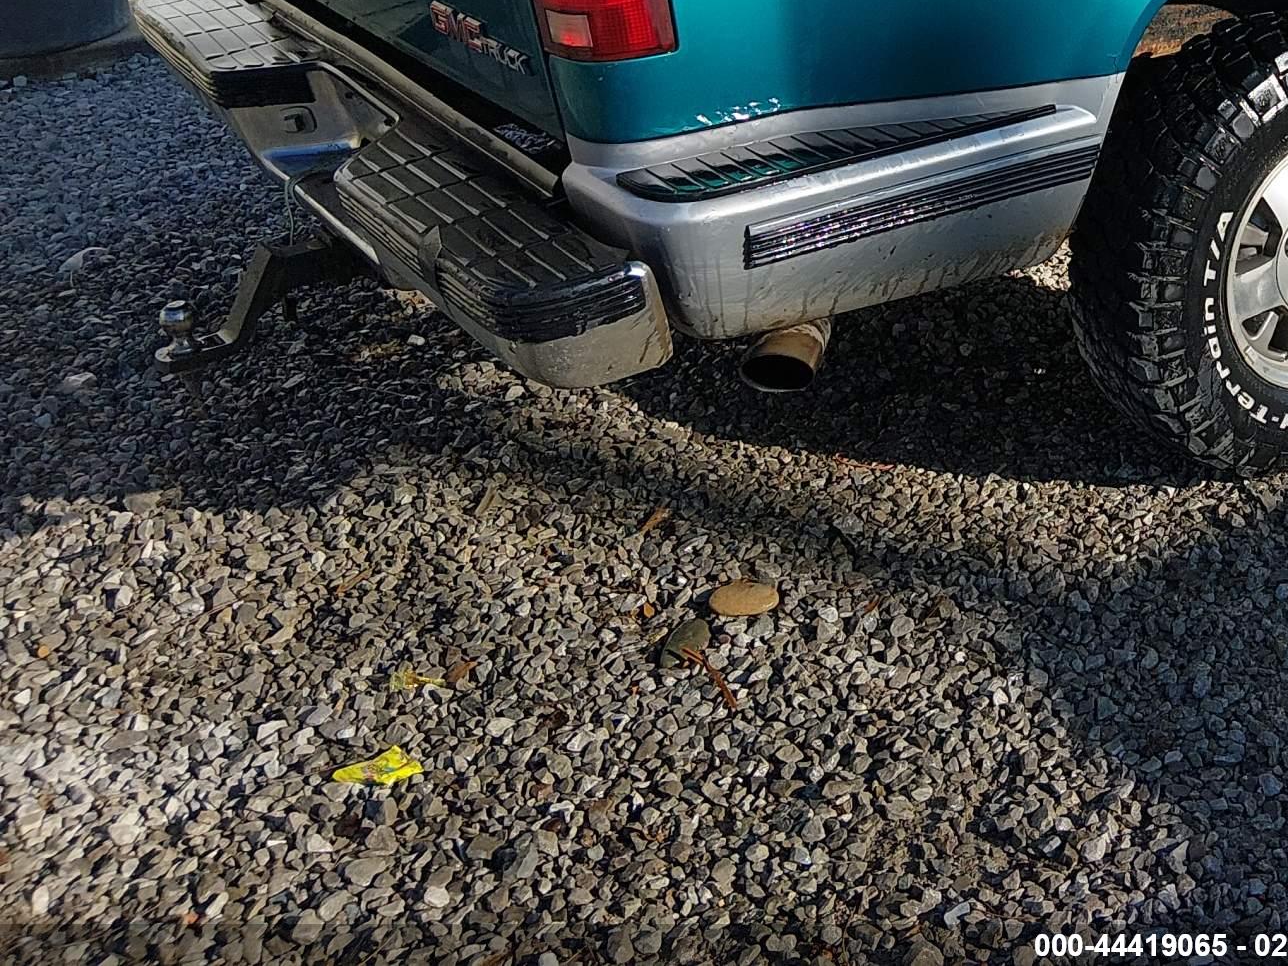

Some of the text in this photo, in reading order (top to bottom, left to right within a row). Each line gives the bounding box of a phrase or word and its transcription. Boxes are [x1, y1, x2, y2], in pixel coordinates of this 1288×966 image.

[430, 0, 528, 74] GMC TRUCK
[1203, 211, 1234, 286] T/A
